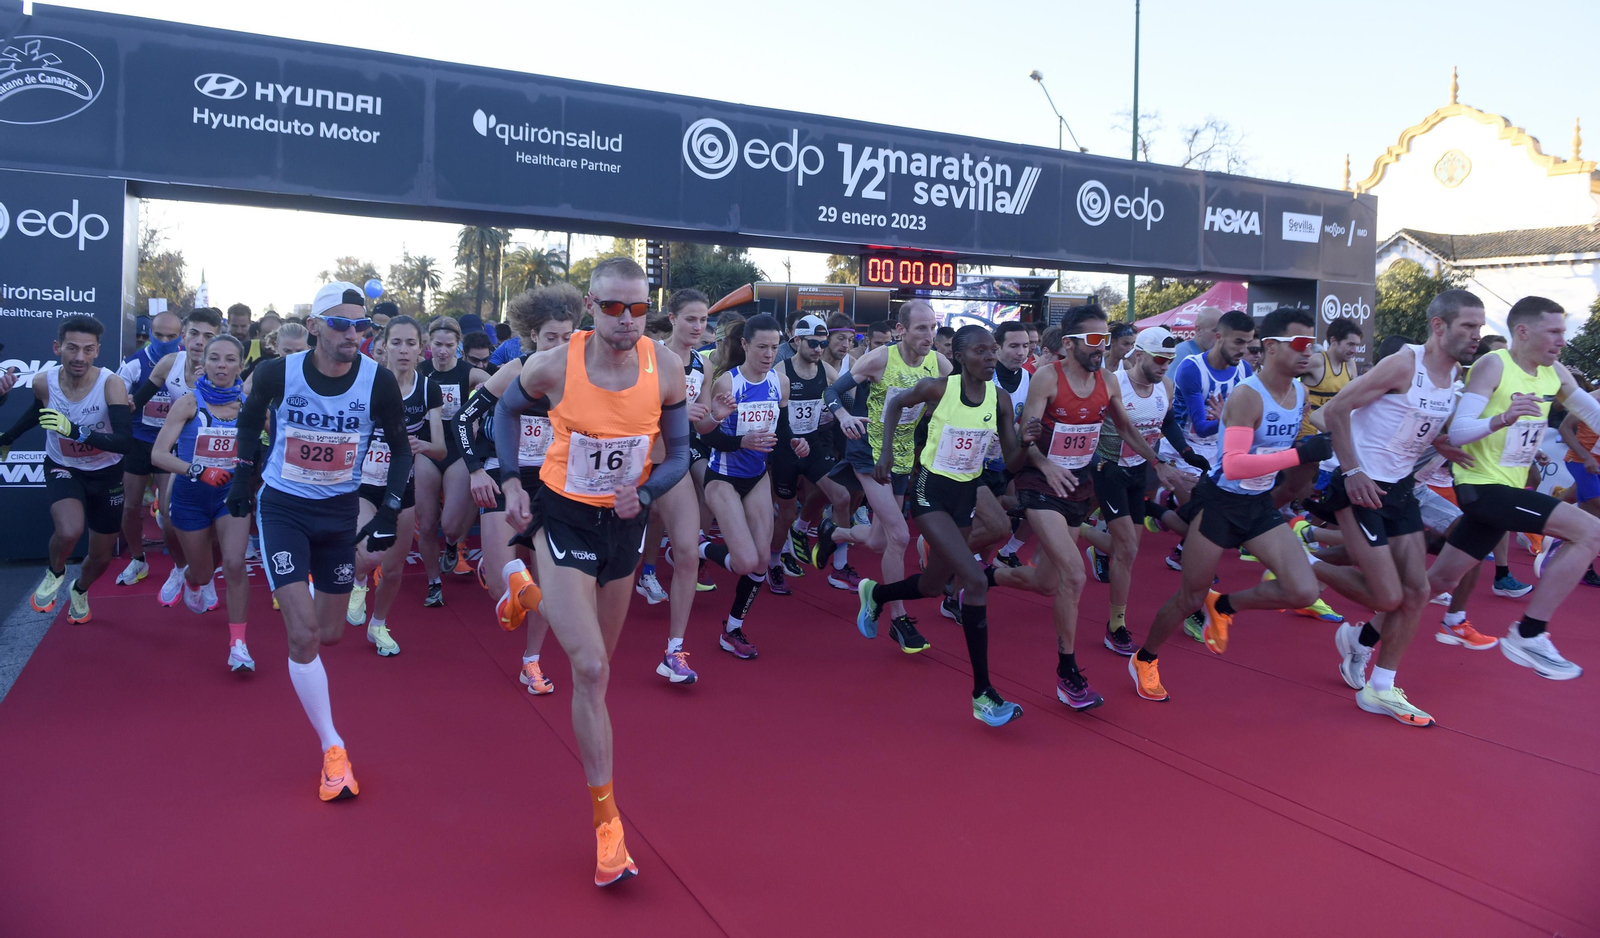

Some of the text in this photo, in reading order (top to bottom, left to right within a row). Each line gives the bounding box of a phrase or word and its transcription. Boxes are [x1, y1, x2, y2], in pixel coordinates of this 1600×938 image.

[24, 74, 36, 84] de
[38, 72, 78, 90] Canarias
[256, 82, 382, 115] HYUNDAI
[193, 107, 380, 144] Hyundauto Motor
[495, 122, 622, 152] quirónsalud
[516, 151, 622, 173] Healthcare Partner
[744, 128, 824, 186] edp
[877, 148, 1012, 187] maratón
[912, 179, 1013, 214] sevilla
[818, 206, 927, 230] 29 enero 2023
[1114, 187, 1164, 230] edp
[16, 199, 109, 250] edp
[1204, 206, 1262, 236] HOKA
[868, 258, 954, 286] 00 00 00
[0, 284, 96, 303] irónsalud
[1342, 296, 1370, 326] edp
[287, 409, 360, 434] nerja
[741, 410, 774, 422] 12679
[796, 406, 812, 419] 33
[524, 425, 542, 437] 36
[1417, 422, 1431, 438] 9
[1522, 430, 1540, 446] 14
[214, 438, 230, 450] 88
[300, 444, 334, 462] 928
[955, 438, 973, 450] 35
[1063, 436, 1086, 450] 913
[590, 450, 624, 470] 16
